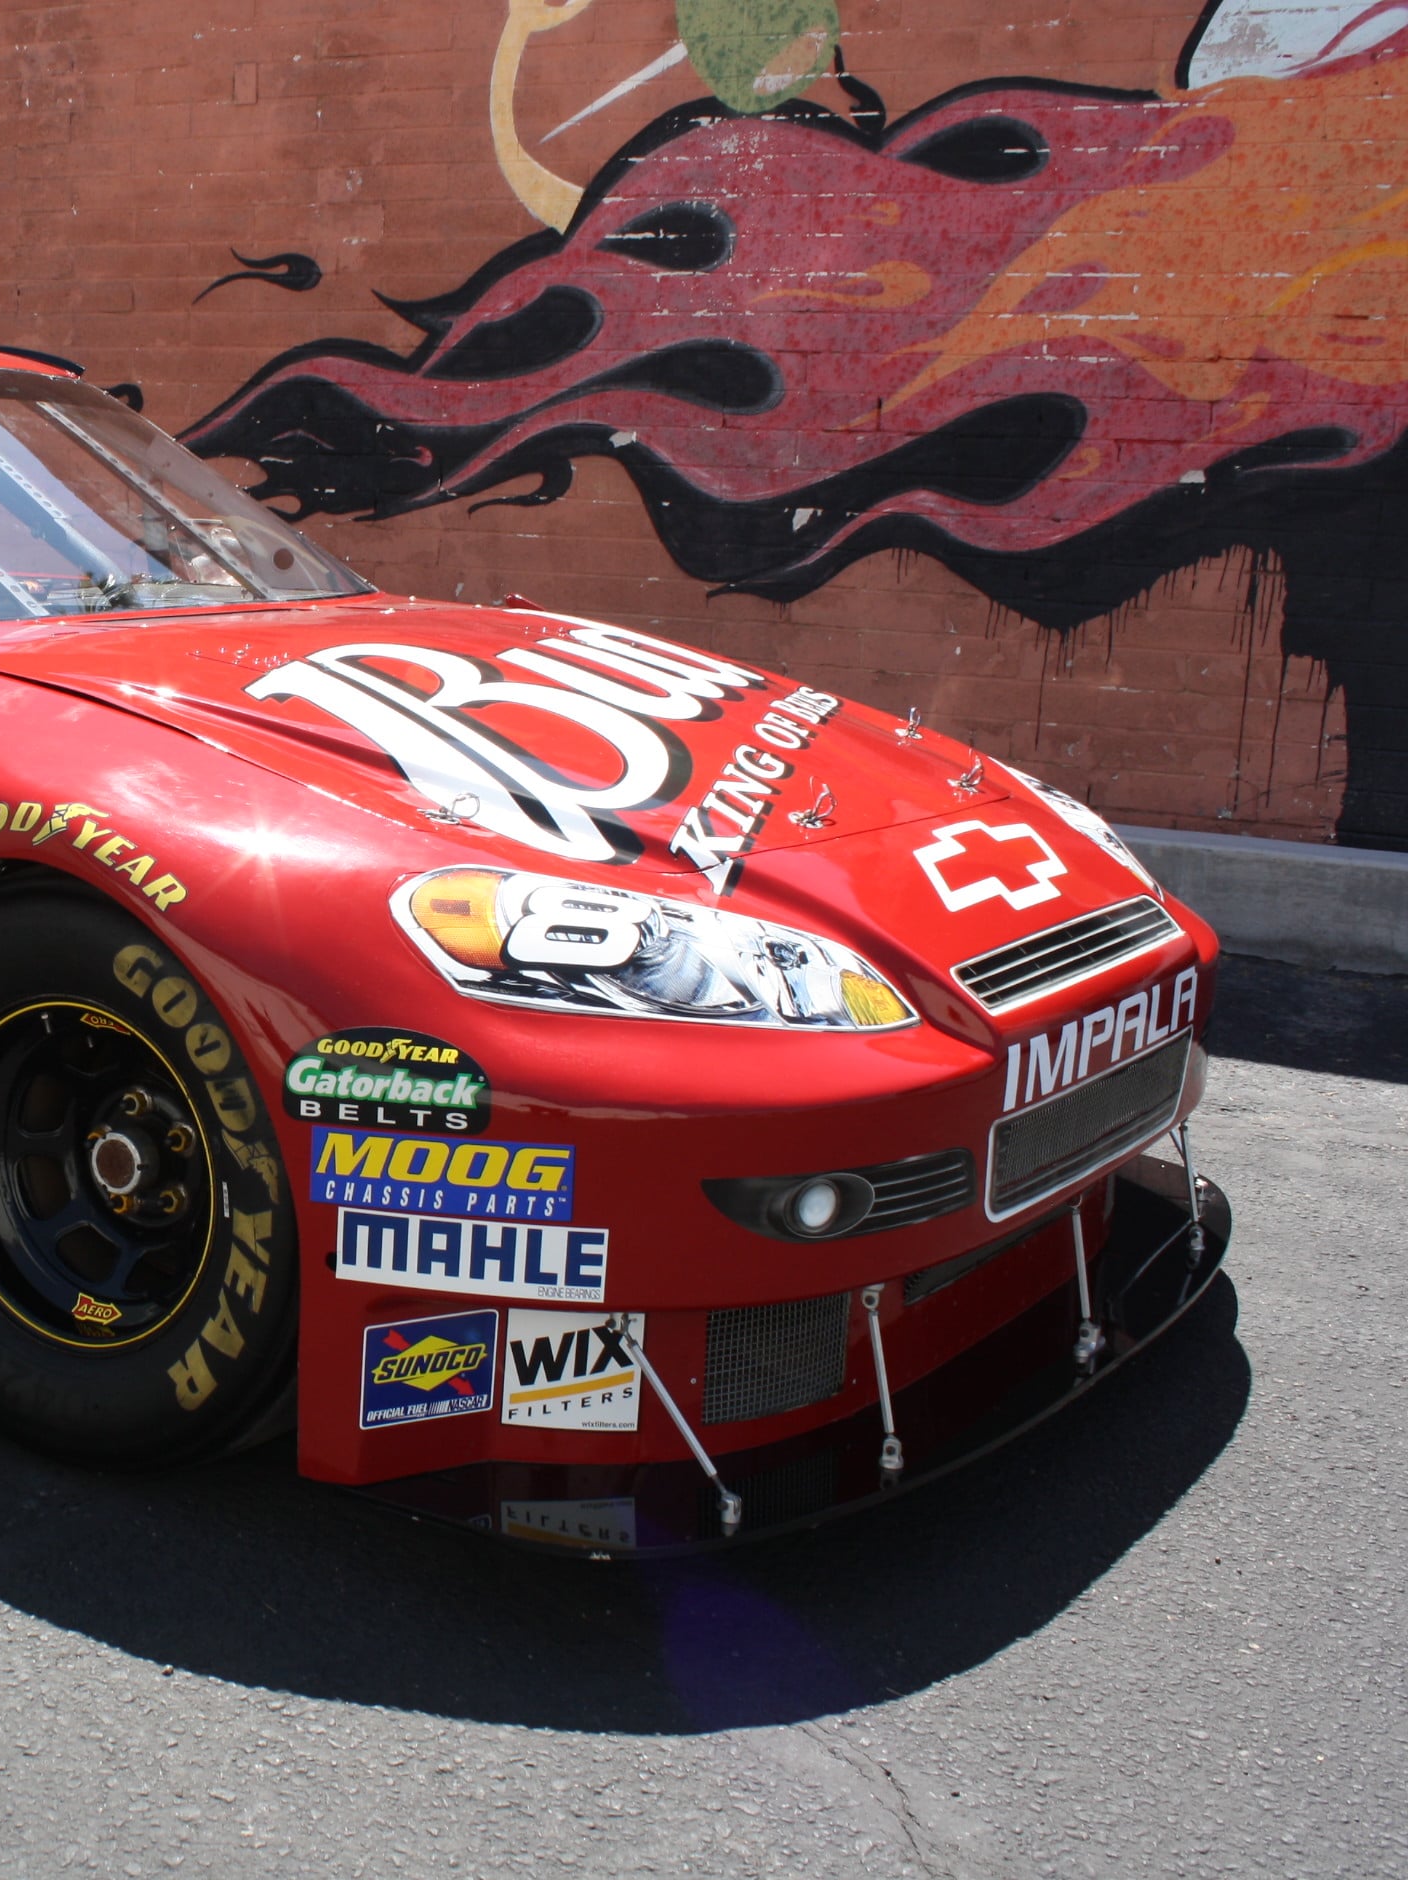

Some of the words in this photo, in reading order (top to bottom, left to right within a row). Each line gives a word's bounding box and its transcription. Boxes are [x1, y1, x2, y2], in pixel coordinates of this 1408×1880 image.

[670, 744, 785, 896] KING
[754, 712, 810, 749] OF
[507, 885, 652, 967] 8
[1003, 966, 1198, 1112] IMPALA
[289, 1057, 482, 1107] Gatorback
[299, 1101, 468, 1130] BELTS
[315, 1132, 571, 1191] MOOG
[326, 1180, 443, 1210] CHASSIS
[467, 1192, 555, 1217] PARTS
[342, 1211, 605, 1287] MAHLE
[78, 1304, 112, 1318] AERO
[538, 1286, 564, 1298] ENGINE
[565, 1287, 601, 1300] BEARINGS
[376, 1344, 487, 1383] SUNOCO
[510, 1326, 634, 1386] WIX
[367, 1406, 404, 1422] OFFICIAL
[407, 1402, 428, 1416] FUEL
[509, 1387, 633, 1420] FILTERS
